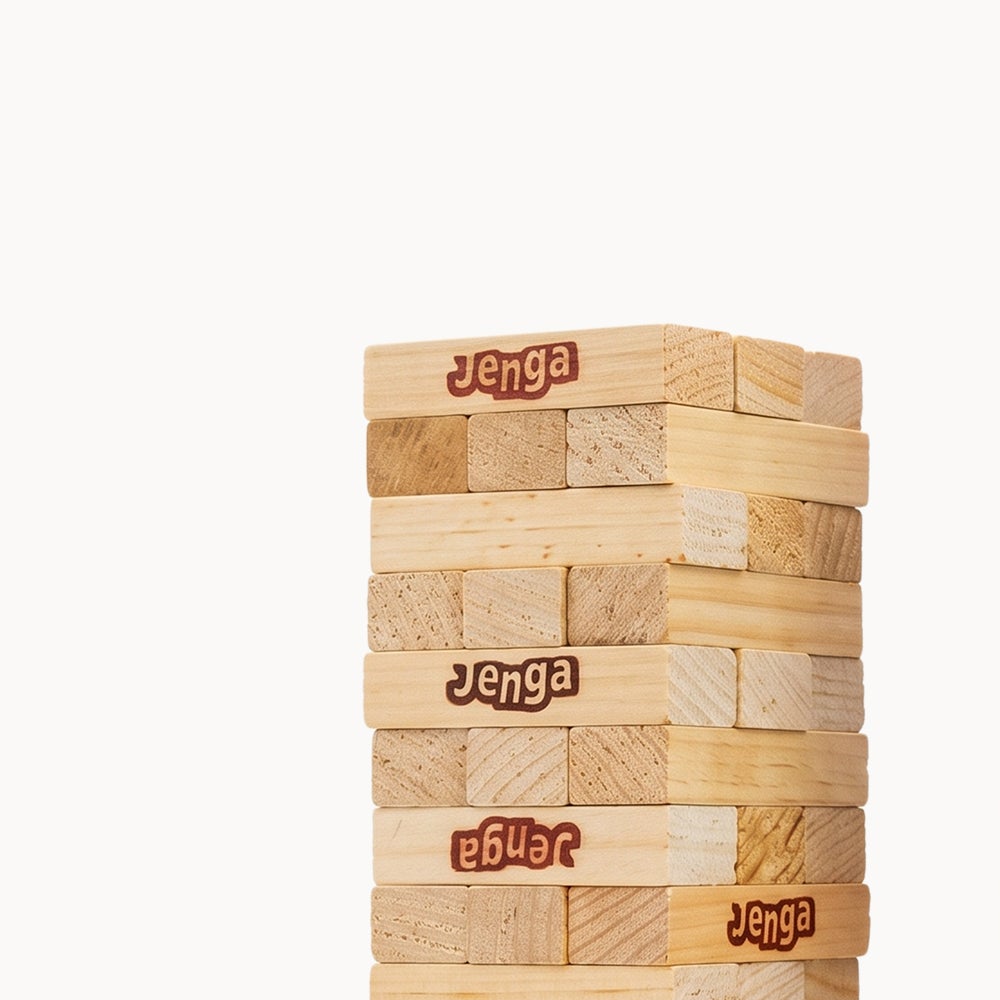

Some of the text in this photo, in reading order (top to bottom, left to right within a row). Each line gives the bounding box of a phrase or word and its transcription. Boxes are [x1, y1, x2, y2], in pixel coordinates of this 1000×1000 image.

[449, 342, 577, 397] Jenga
[449, 656, 577, 709] Jenga
[453, 819, 579, 870] Jenga
[729, 899, 813, 949] Jenga
